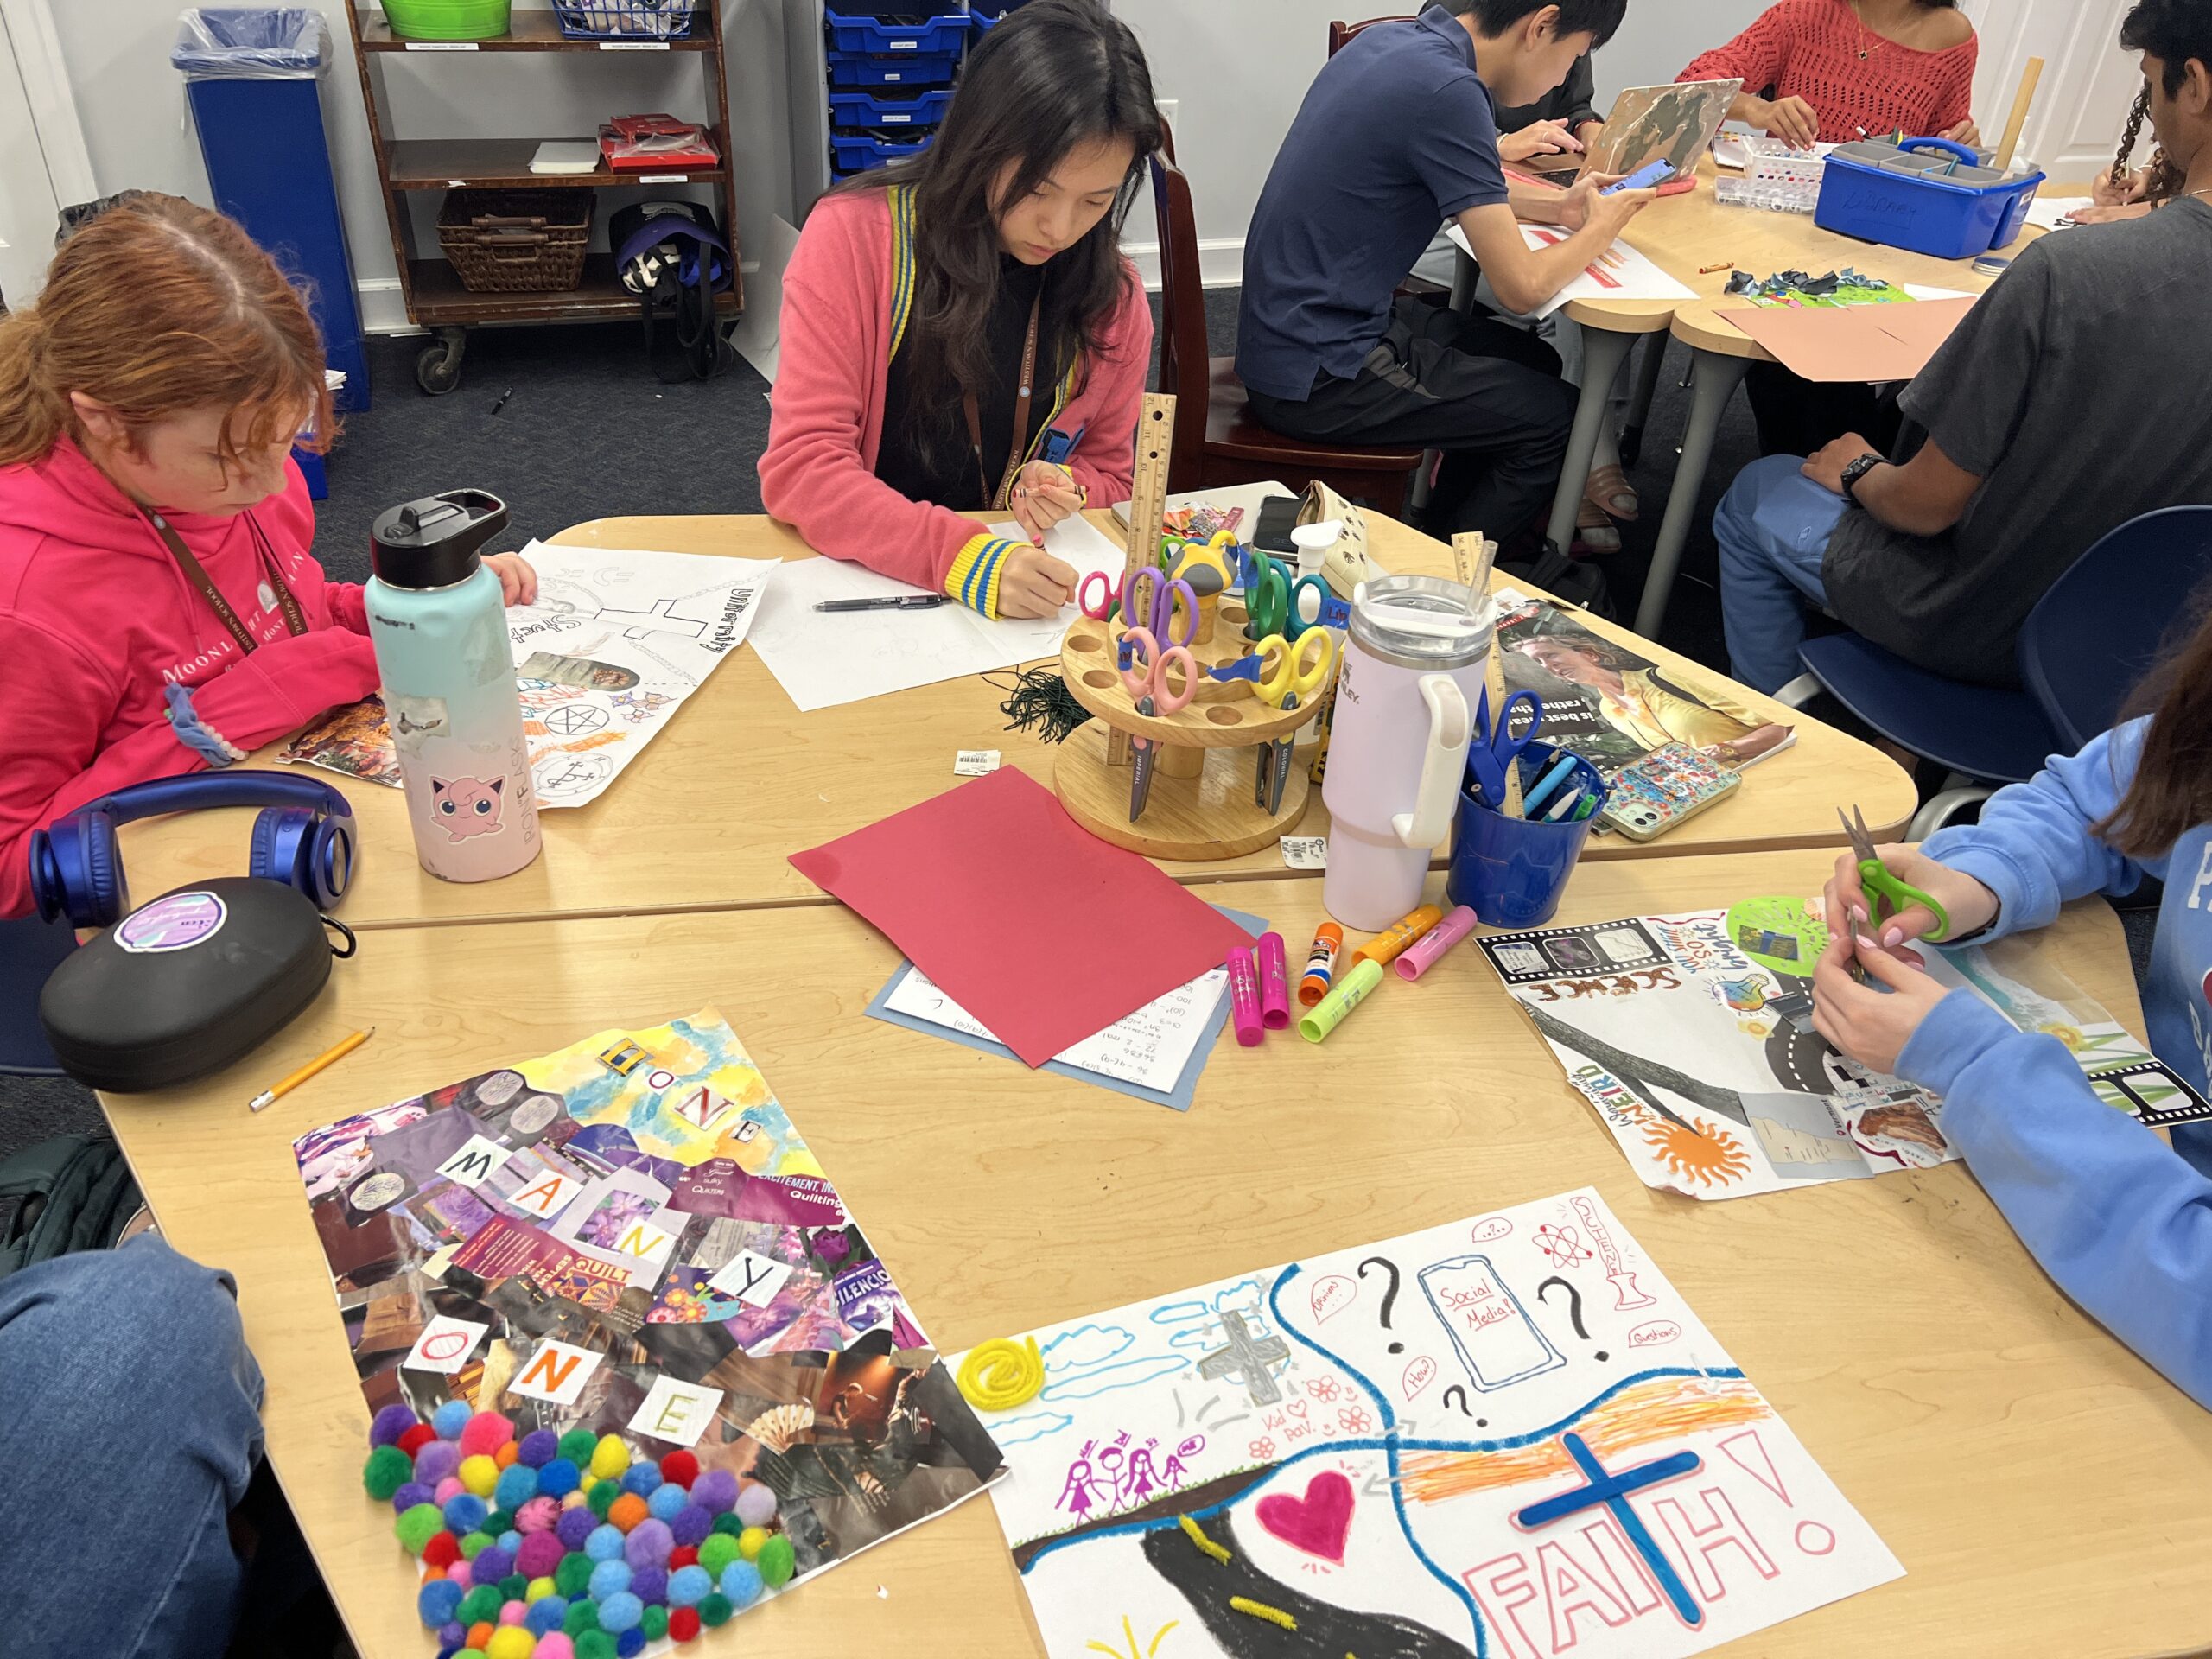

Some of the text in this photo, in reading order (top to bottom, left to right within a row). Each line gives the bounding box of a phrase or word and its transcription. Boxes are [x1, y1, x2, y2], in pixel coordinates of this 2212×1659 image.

[1542, 697, 1581, 710] rathe
[1549, 713, 1582, 724] best
[1280, 747, 1289, 780] COLONIAL
[1821, 1098, 1842, 1128] Vermont
[790, 1190, 844, 1209] Quilting
[574, 1256, 633, 1282] QUILT
[836, 1268, 893, 1306] ILENCIO
[1440, 1278, 1492, 1307] Social
[1467, 1299, 1516, 1328] Media!
[1633, 1327, 1678, 1344] Questions
[1408, 1359, 1432, 1389] How?
[1262, 1408, 1287, 1431] Kid
